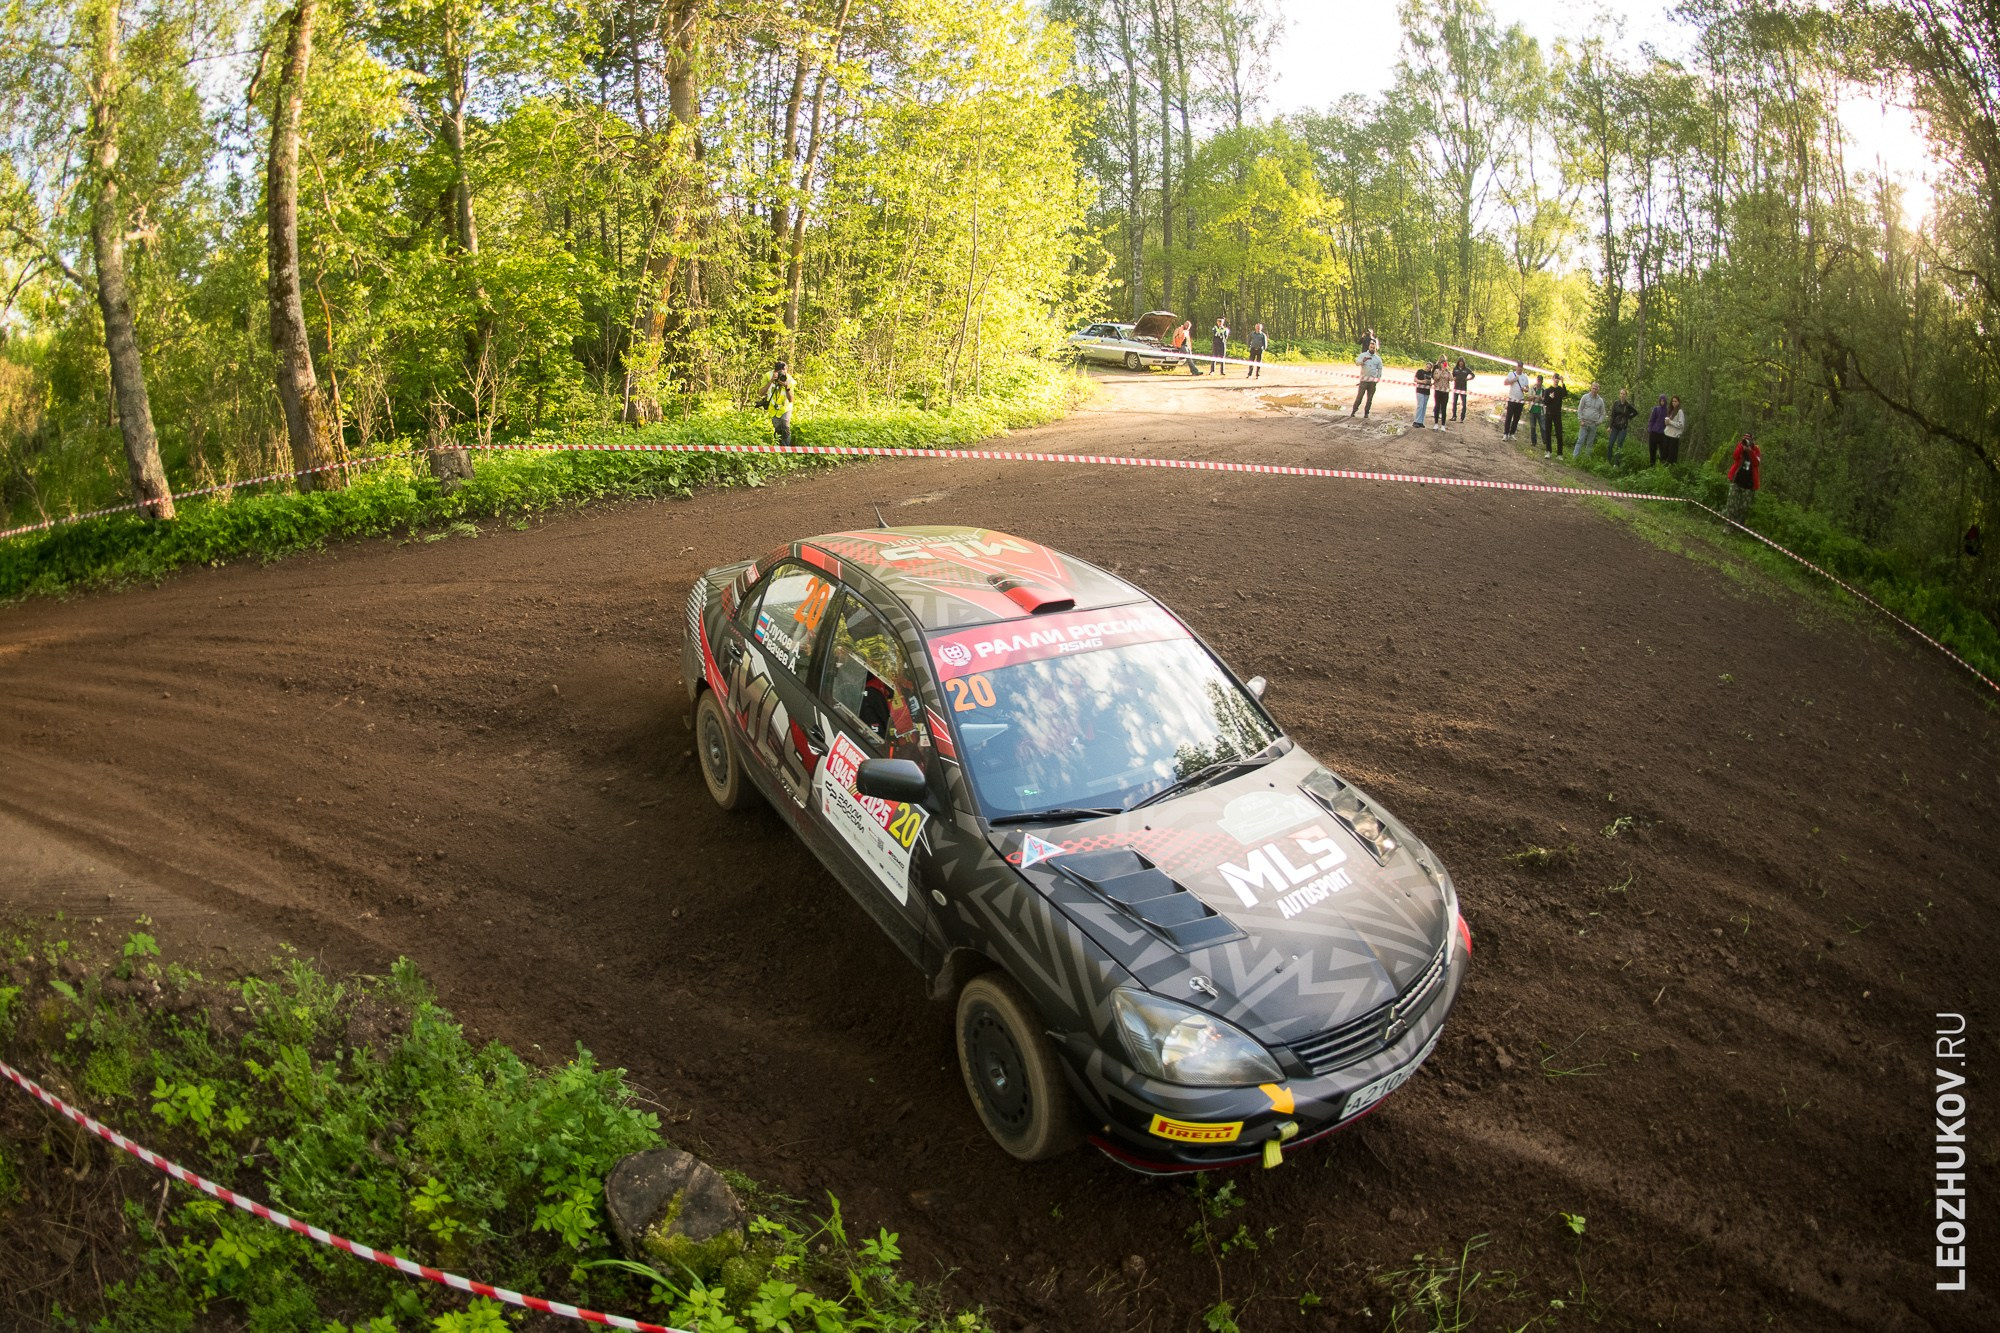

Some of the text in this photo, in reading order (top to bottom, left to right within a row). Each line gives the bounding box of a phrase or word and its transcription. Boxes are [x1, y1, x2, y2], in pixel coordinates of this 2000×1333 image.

[879, 539, 1035, 561] MLS
[793, 576, 830, 631] 20
[761, 631, 797, 675] Рвачев А.
[766, 617, 801, 659] Глухов А.
[974, 627, 1064, 658] РАЛЛИ
[945, 675, 997, 713] 20
[829, 754, 857, 791] 1945
[845, 747, 863, 769] ПОБЕ
[888, 802, 920, 847] 20
[1217, 824, 1347, 908] MLS
[1276, 867, 1352, 919] AUTOSPORT
[1158, 1120, 1235, 1139] PIRELLI
